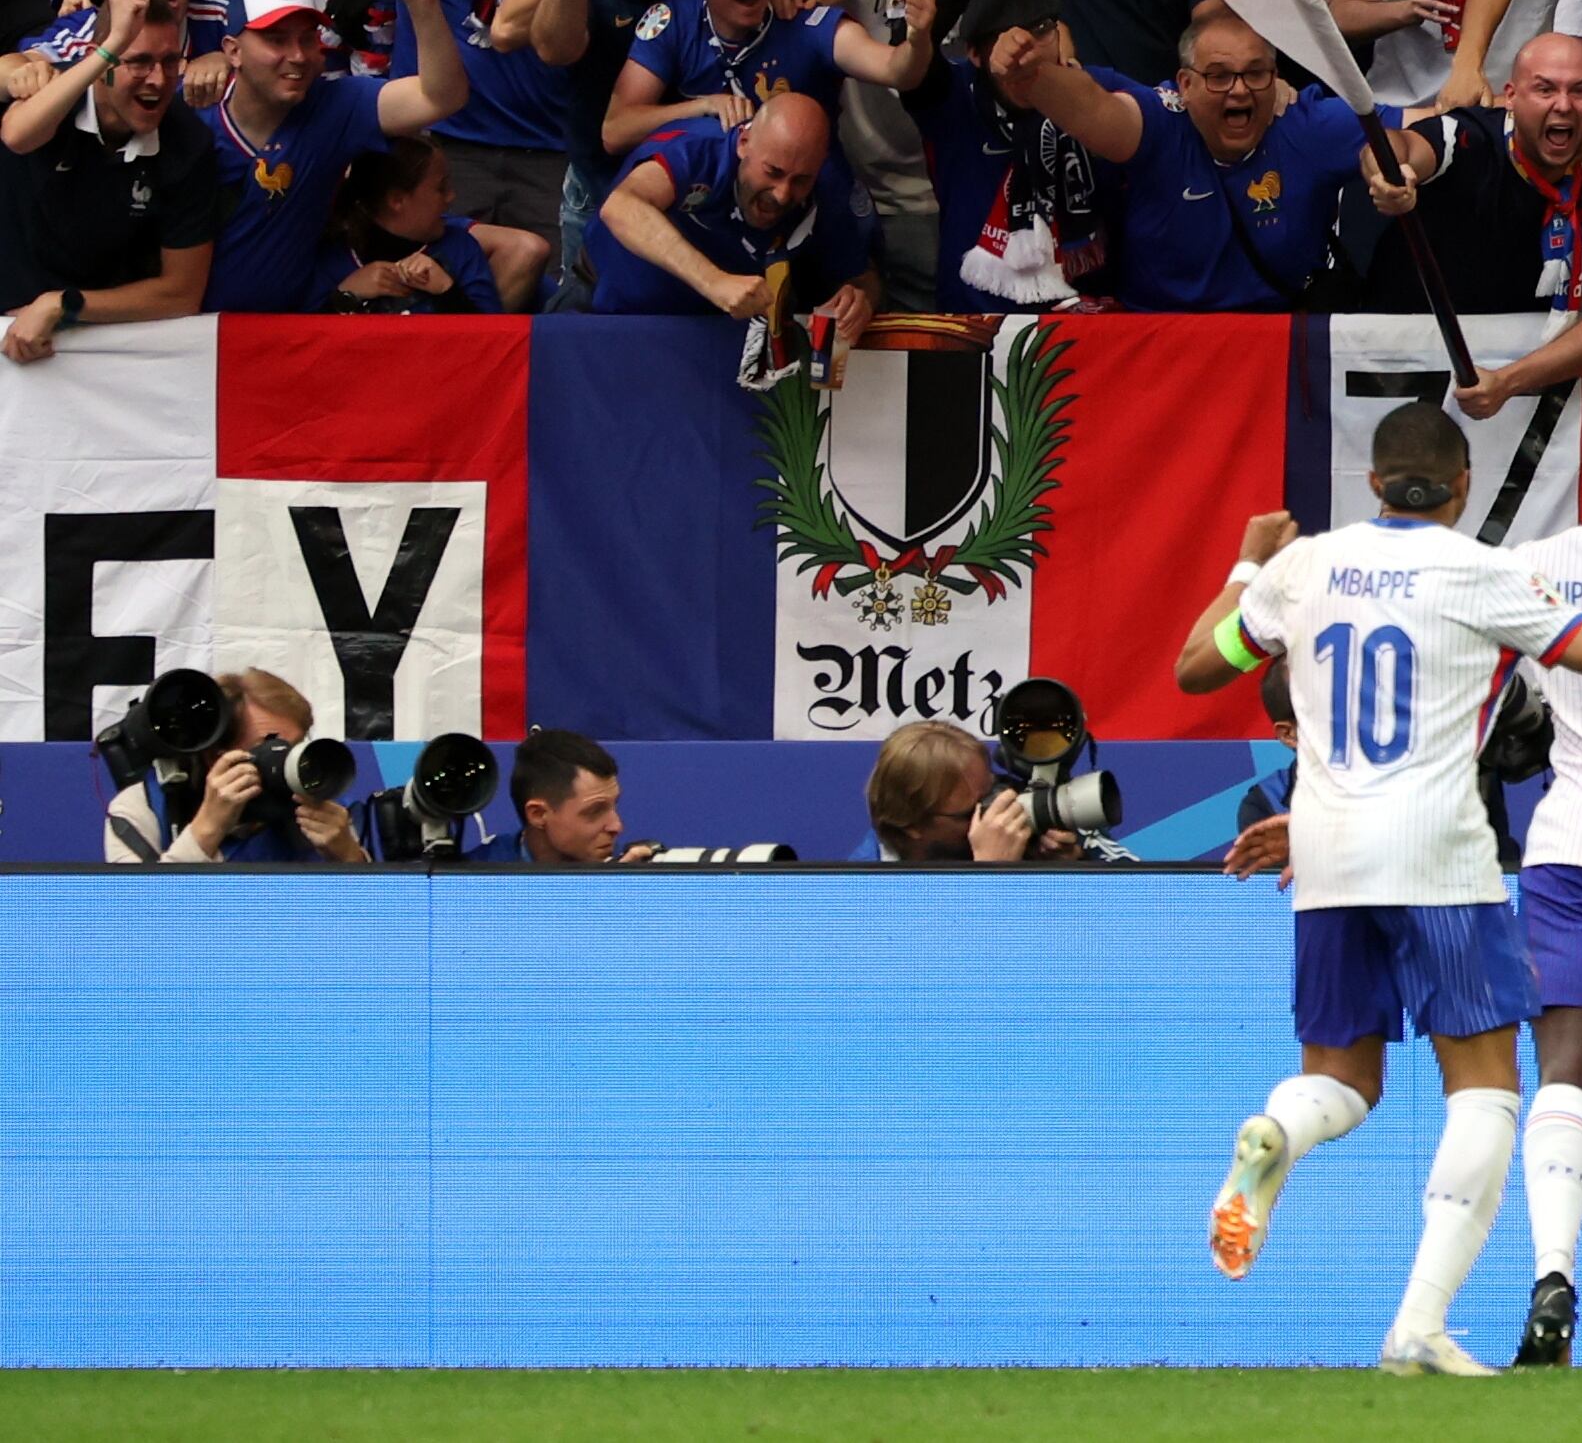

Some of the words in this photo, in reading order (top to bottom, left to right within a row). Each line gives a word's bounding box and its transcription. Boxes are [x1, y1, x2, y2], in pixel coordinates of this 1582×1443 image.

[1326, 567, 1420, 601] MBAPPE
[797, 644, 1004, 738] Metz
[1313, 623, 1416, 771] 10
